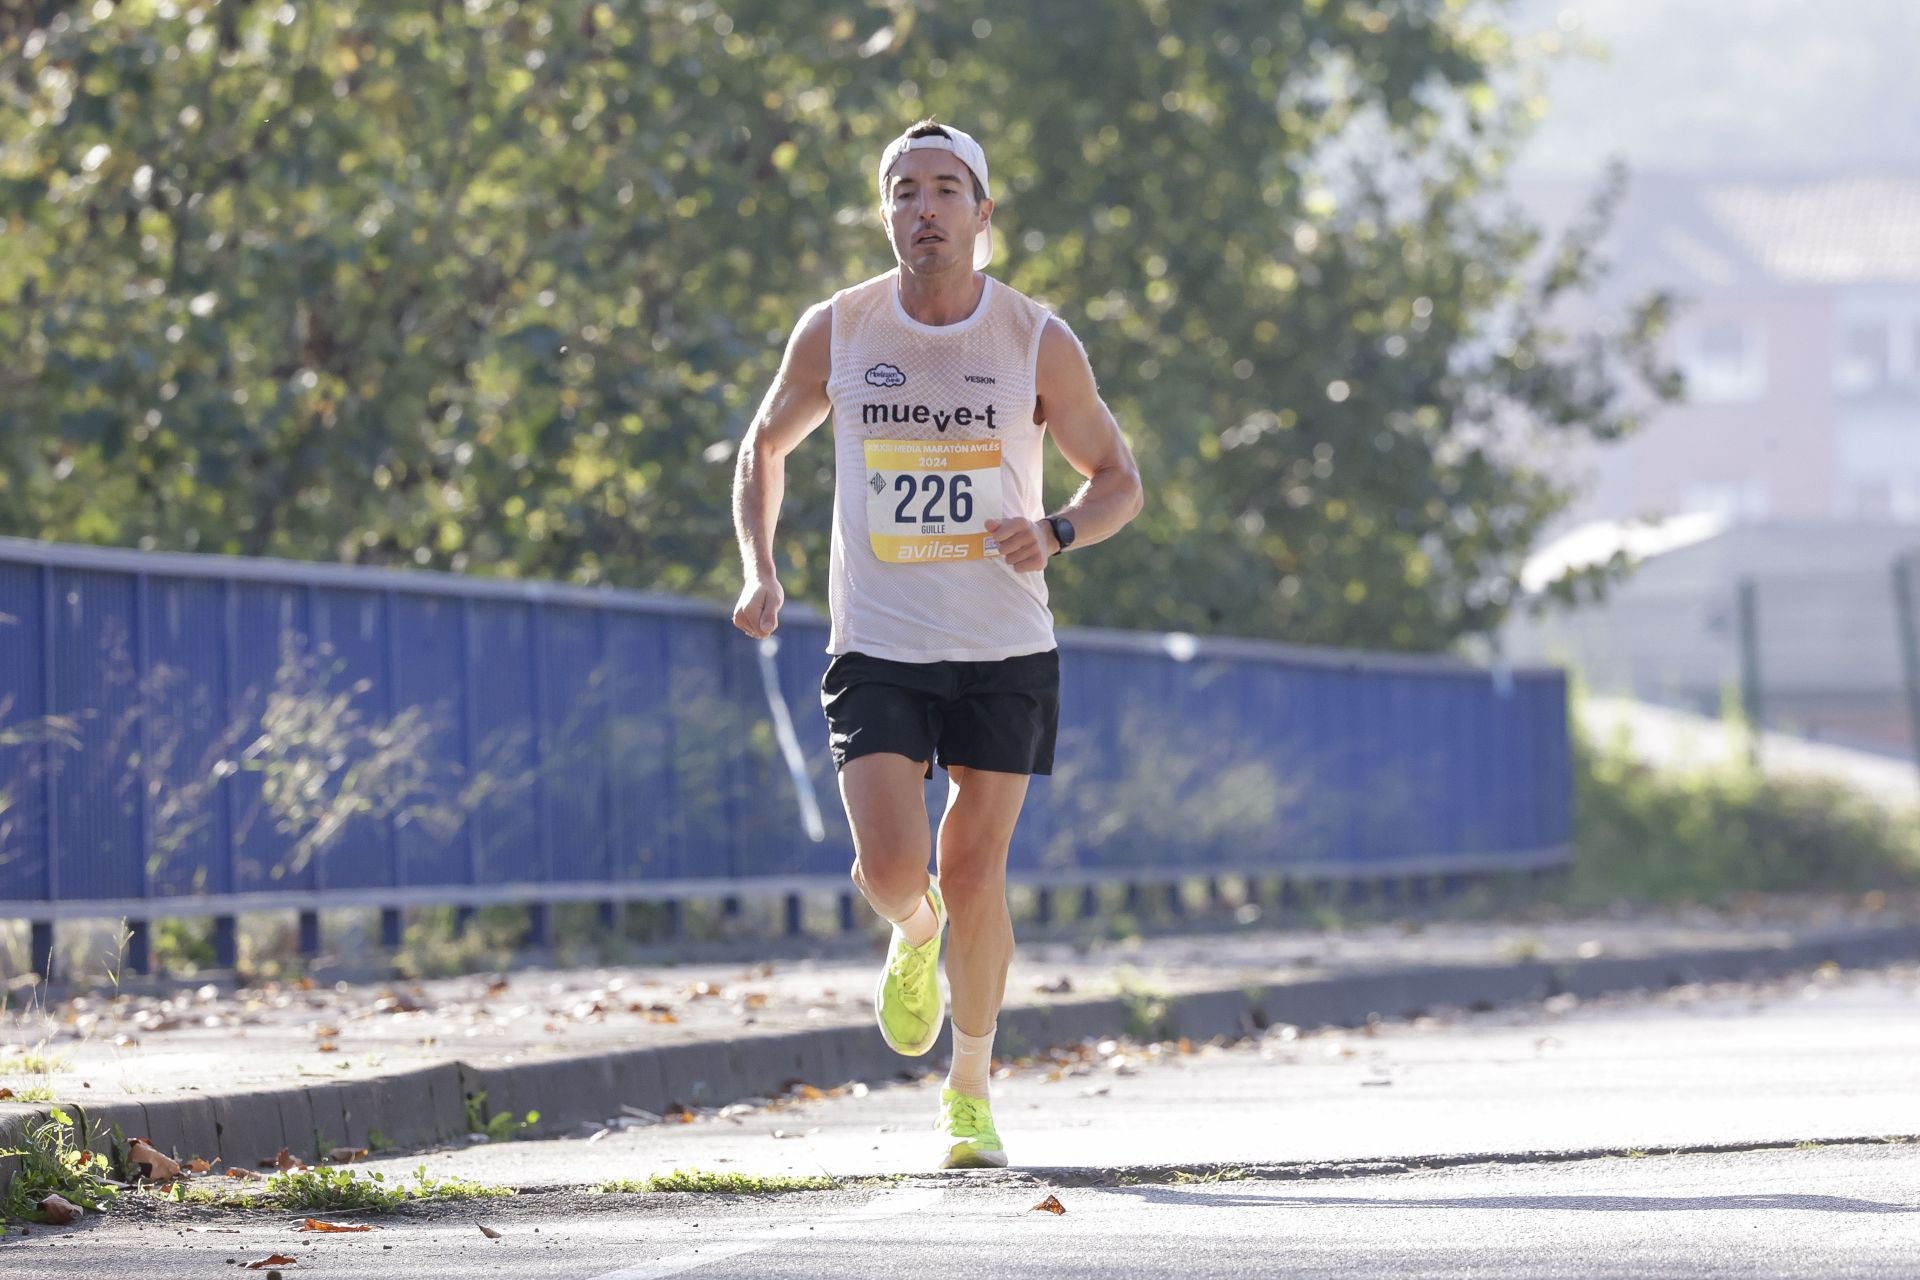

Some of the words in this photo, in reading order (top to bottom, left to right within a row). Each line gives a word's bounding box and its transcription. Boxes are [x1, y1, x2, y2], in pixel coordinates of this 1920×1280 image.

[964, 375, 996, 385] VESKIN
[894, 444, 921, 454] MEDIA
[923, 443, 969, 454] MARATÓN
[970, 441, 1000, 453] AVILÉS
[919, 457, 948, 468] 2024
[894, 474, 973, 523] 226
[921, 524, 946, 535] GUILLE
